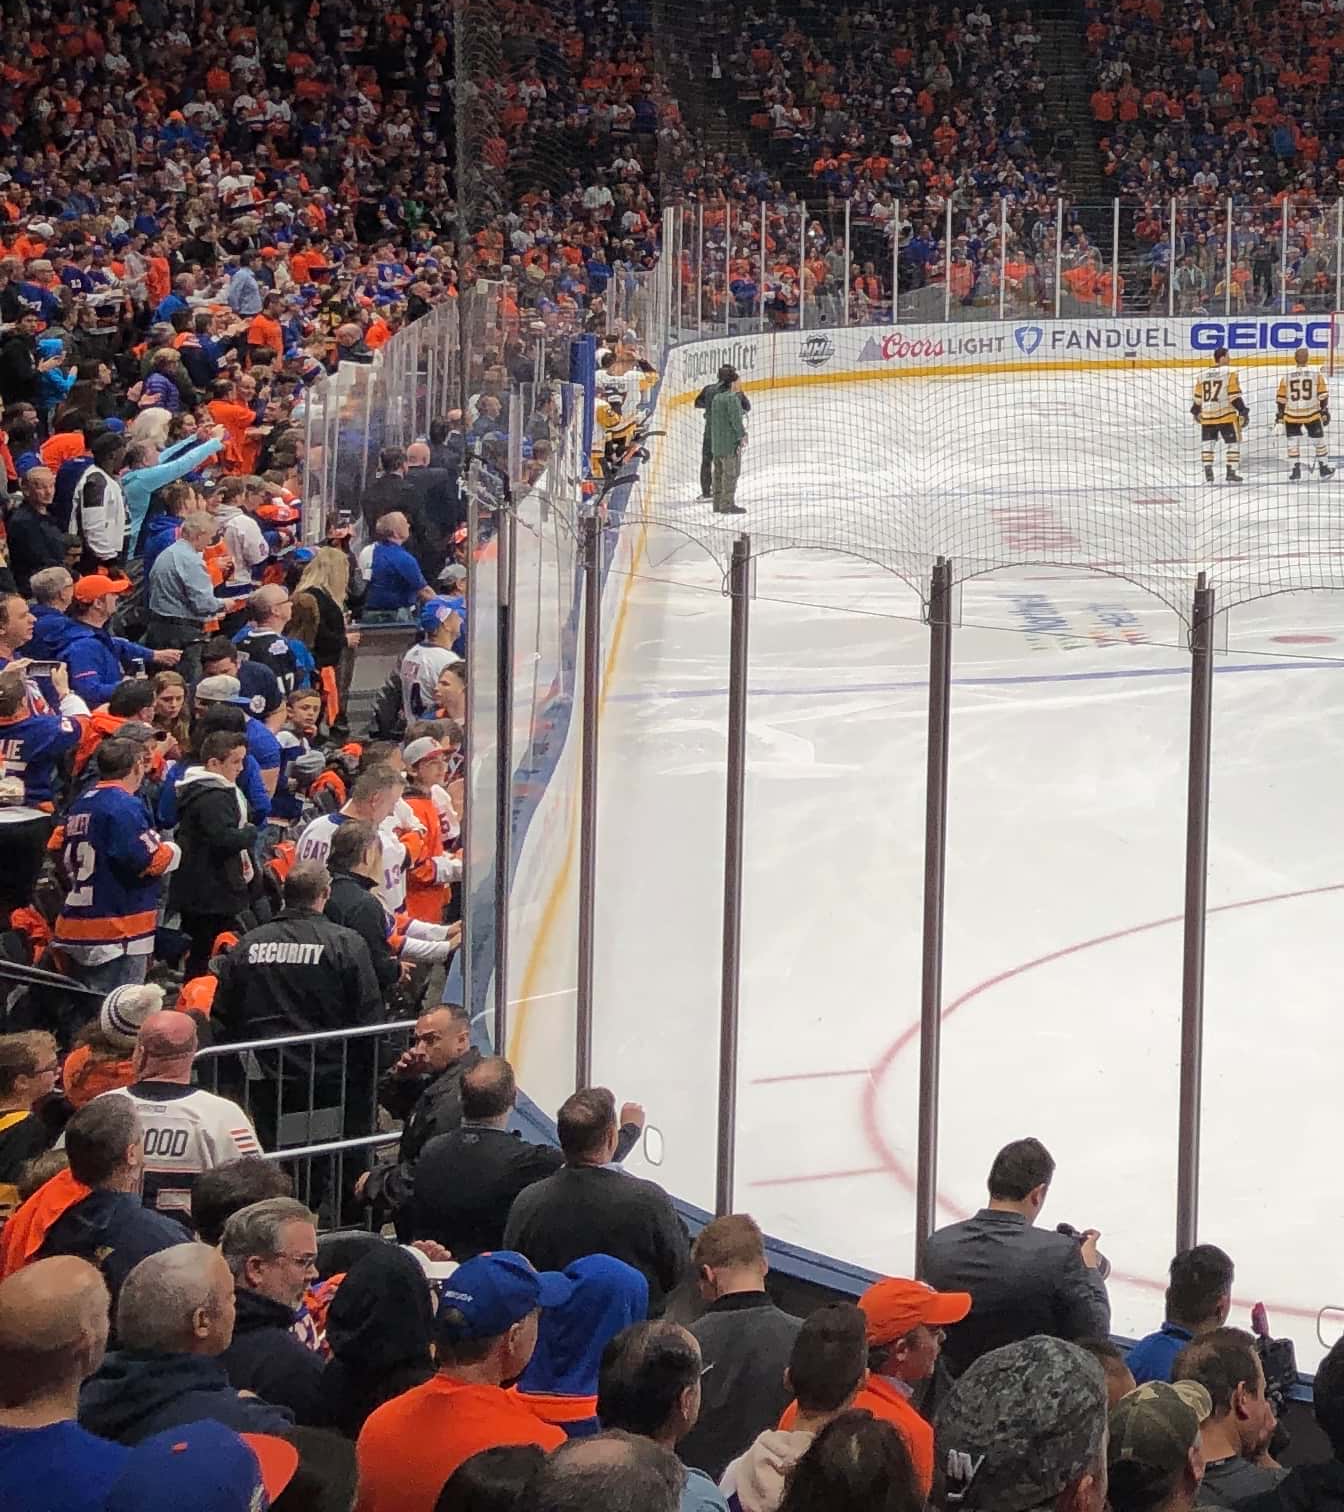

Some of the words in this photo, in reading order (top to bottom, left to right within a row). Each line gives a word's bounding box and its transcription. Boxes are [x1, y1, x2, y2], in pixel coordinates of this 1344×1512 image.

[882, 333, 944, 360] Coors
[947, 336, 1005, 355] LIGHT
[1051, 327, 1177, 350] FANDUEL
[1190, 321, 1340, 351] GEICO
[1202, 380, 1223, 402] 87
[1289, 379, 1313, 401] 59
[248, 942, 325, 965] SECURITY
[144, 1127, 189, 1157] OOD
